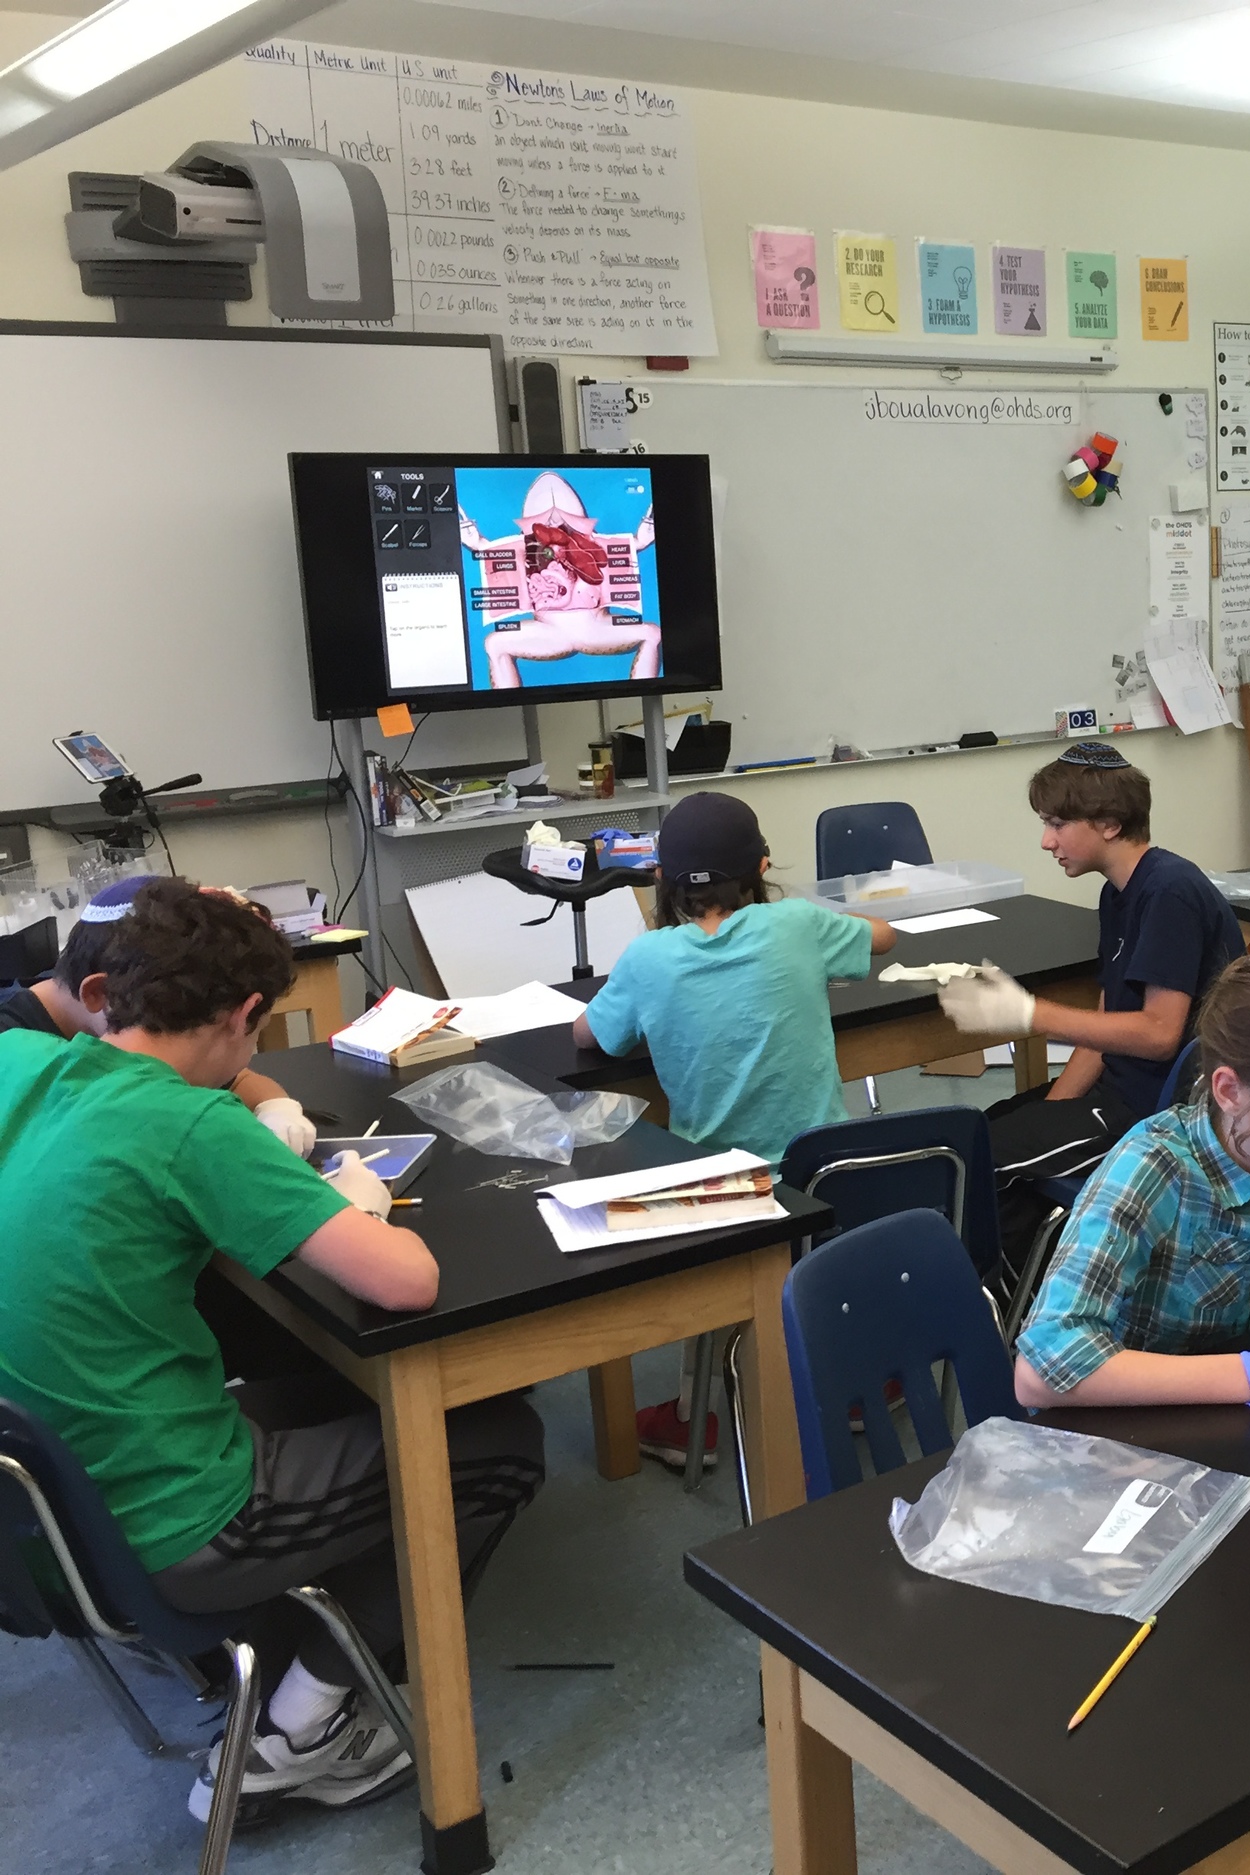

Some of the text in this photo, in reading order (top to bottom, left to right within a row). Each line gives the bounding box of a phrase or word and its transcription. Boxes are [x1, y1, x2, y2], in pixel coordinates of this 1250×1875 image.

[313, 50, 354, 69] Metric
[361, 56, 387, 72] Unit
[433, 64, 457, 80] unit
[570, 80, 608, 102] Laws
[614, 85, 629, 110] of
[635, 88, 675, 111] Motion
[457, 97, 483, 113] miles
[546, 117, 584, 134] Change
[340, 131, 396, 163] meter
[445, 131, 478, 148] yards
[651, 143, 678, 160] start
[450, 160, 474, 177] feet
[457, 196, 492, 214] inches
[522, 202, 543, 217] force
[591, 205, 625, 223] change
[606, 228, 632, 238] mass
[460, 233, 495, 250] pounds
[853, 248, 864, 262] DO
[865, 248, 885, 263] YOUR
[1006, 256, 1022, 268] TEST
[458, 266, 497, 281] ounces
[846, 262, 884, 278] RESEARCH
[1000, 269, 1018, 282] YOUR
[1151, 268, 1169, 280] DRAW
[773, 288, 789, 302] ASK
[1001, 283, 1041, 298] HYPOTHESIS
[1145, 281, 1186, 294] CONCLUSIONS
[458, 298, 499, 315] gallons
[659, 295, 687, 311] force
[766, 303, 812, 319] A QUESTION
[936, 298, 956, 312] FORM
[1082, 303, 1109, 316] ANALYZE
[929, 313, 971, 328] HYPOTHESIS
[1075, 316, 1109, 330] YOUR DATA
[1217, 327, 1241, 340] How
[637, 392, 651, 405] 15
[864, 390, 1073, 425] jboualavong@ohds.org
[632, 443, 647, 455] 16
[1070, 711, 1095, 728] 03
